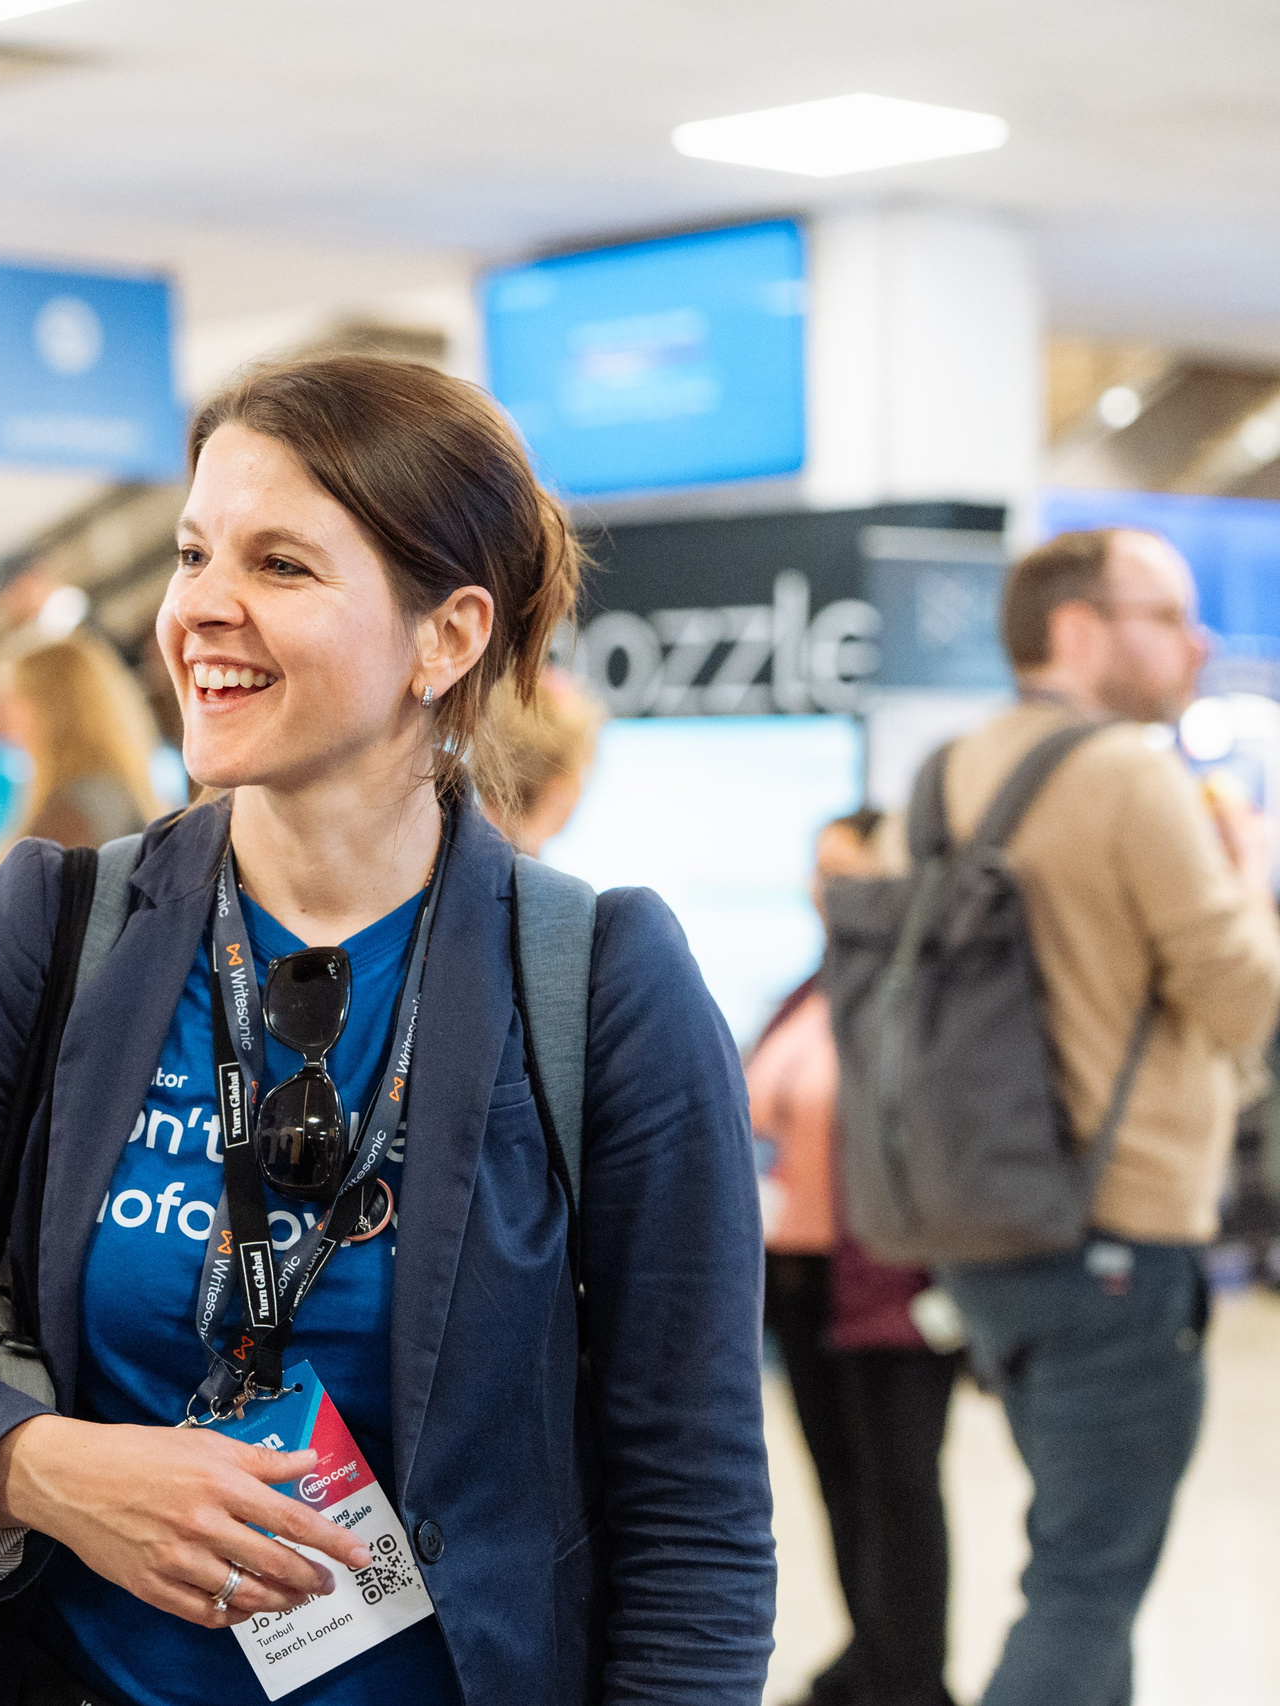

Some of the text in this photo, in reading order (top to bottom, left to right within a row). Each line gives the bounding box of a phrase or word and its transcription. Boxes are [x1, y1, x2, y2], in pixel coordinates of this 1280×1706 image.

[230, 967, 252, 1051] Writesonic
[151, 1066, 189, 1089] tor
[228, 1071, 243, 1139] Turn Global
[200, 1259, 231, 1341] Writesoni
[250, 1250, 270, 1320] Turn Global
[304, 1460, 358, 1496] HERO CONF
[332, 1509, 351, 1525] ing
[343, 1505, 373, 1530] ssible
[251, 1616, 270, 1634] Jo
[256, 1622, 295, 1648] Turnbull
[265, 1613, 354, 1665] Search London
